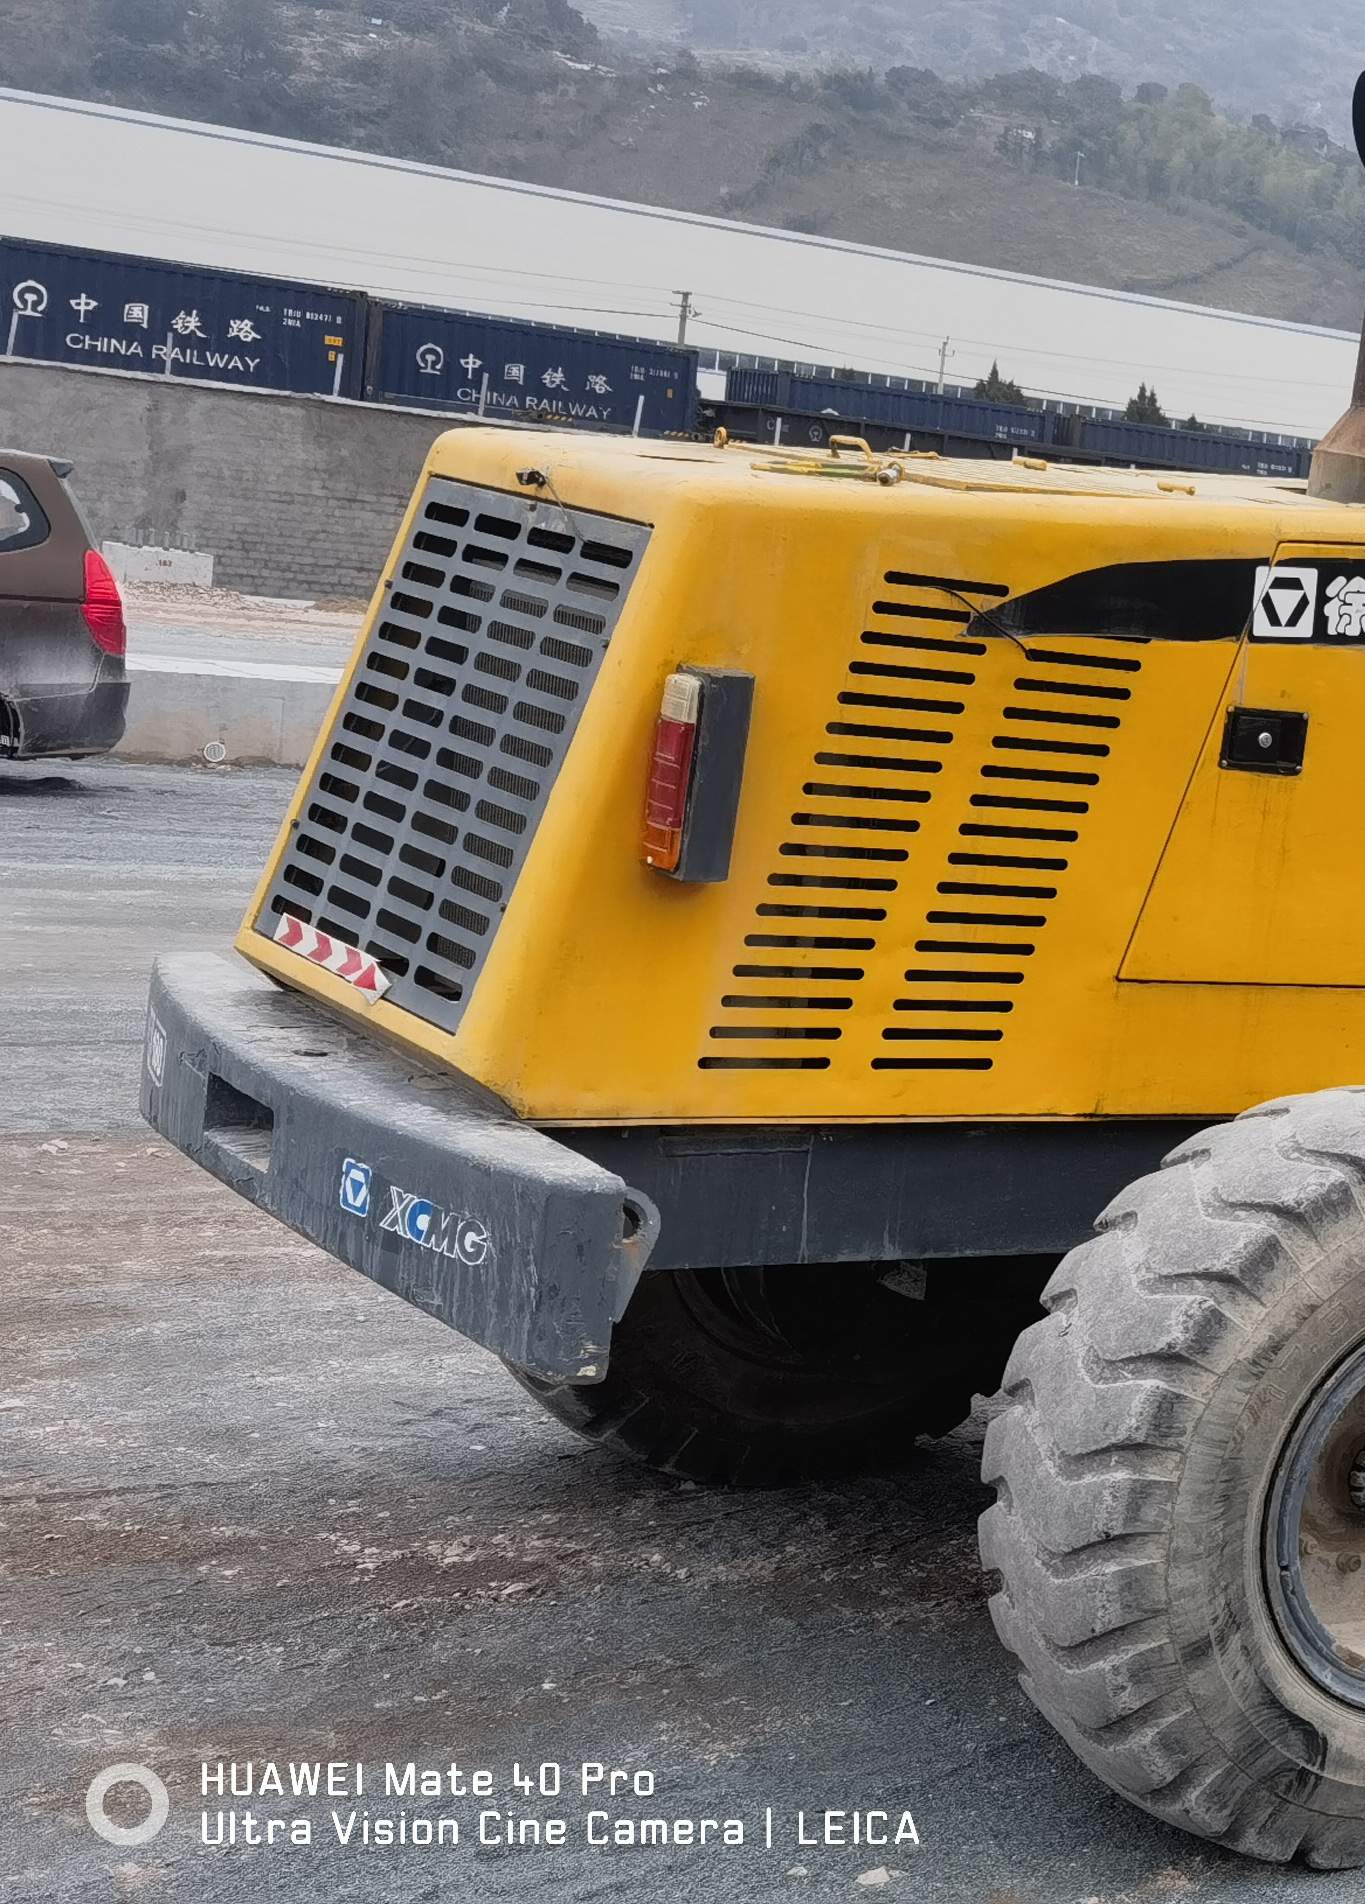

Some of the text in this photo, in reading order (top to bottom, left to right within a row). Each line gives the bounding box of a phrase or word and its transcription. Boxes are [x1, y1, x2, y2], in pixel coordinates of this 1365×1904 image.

[69, 293, 262, 342] 中国铁路
[65, 333, 260, 373] CHINA RAILWAY
[459, 353, 613, 394] 中国铁路
[456, 387, 612, 421] CHINA RAILWAY
[379, 1185, 488, 1266] XCMG
